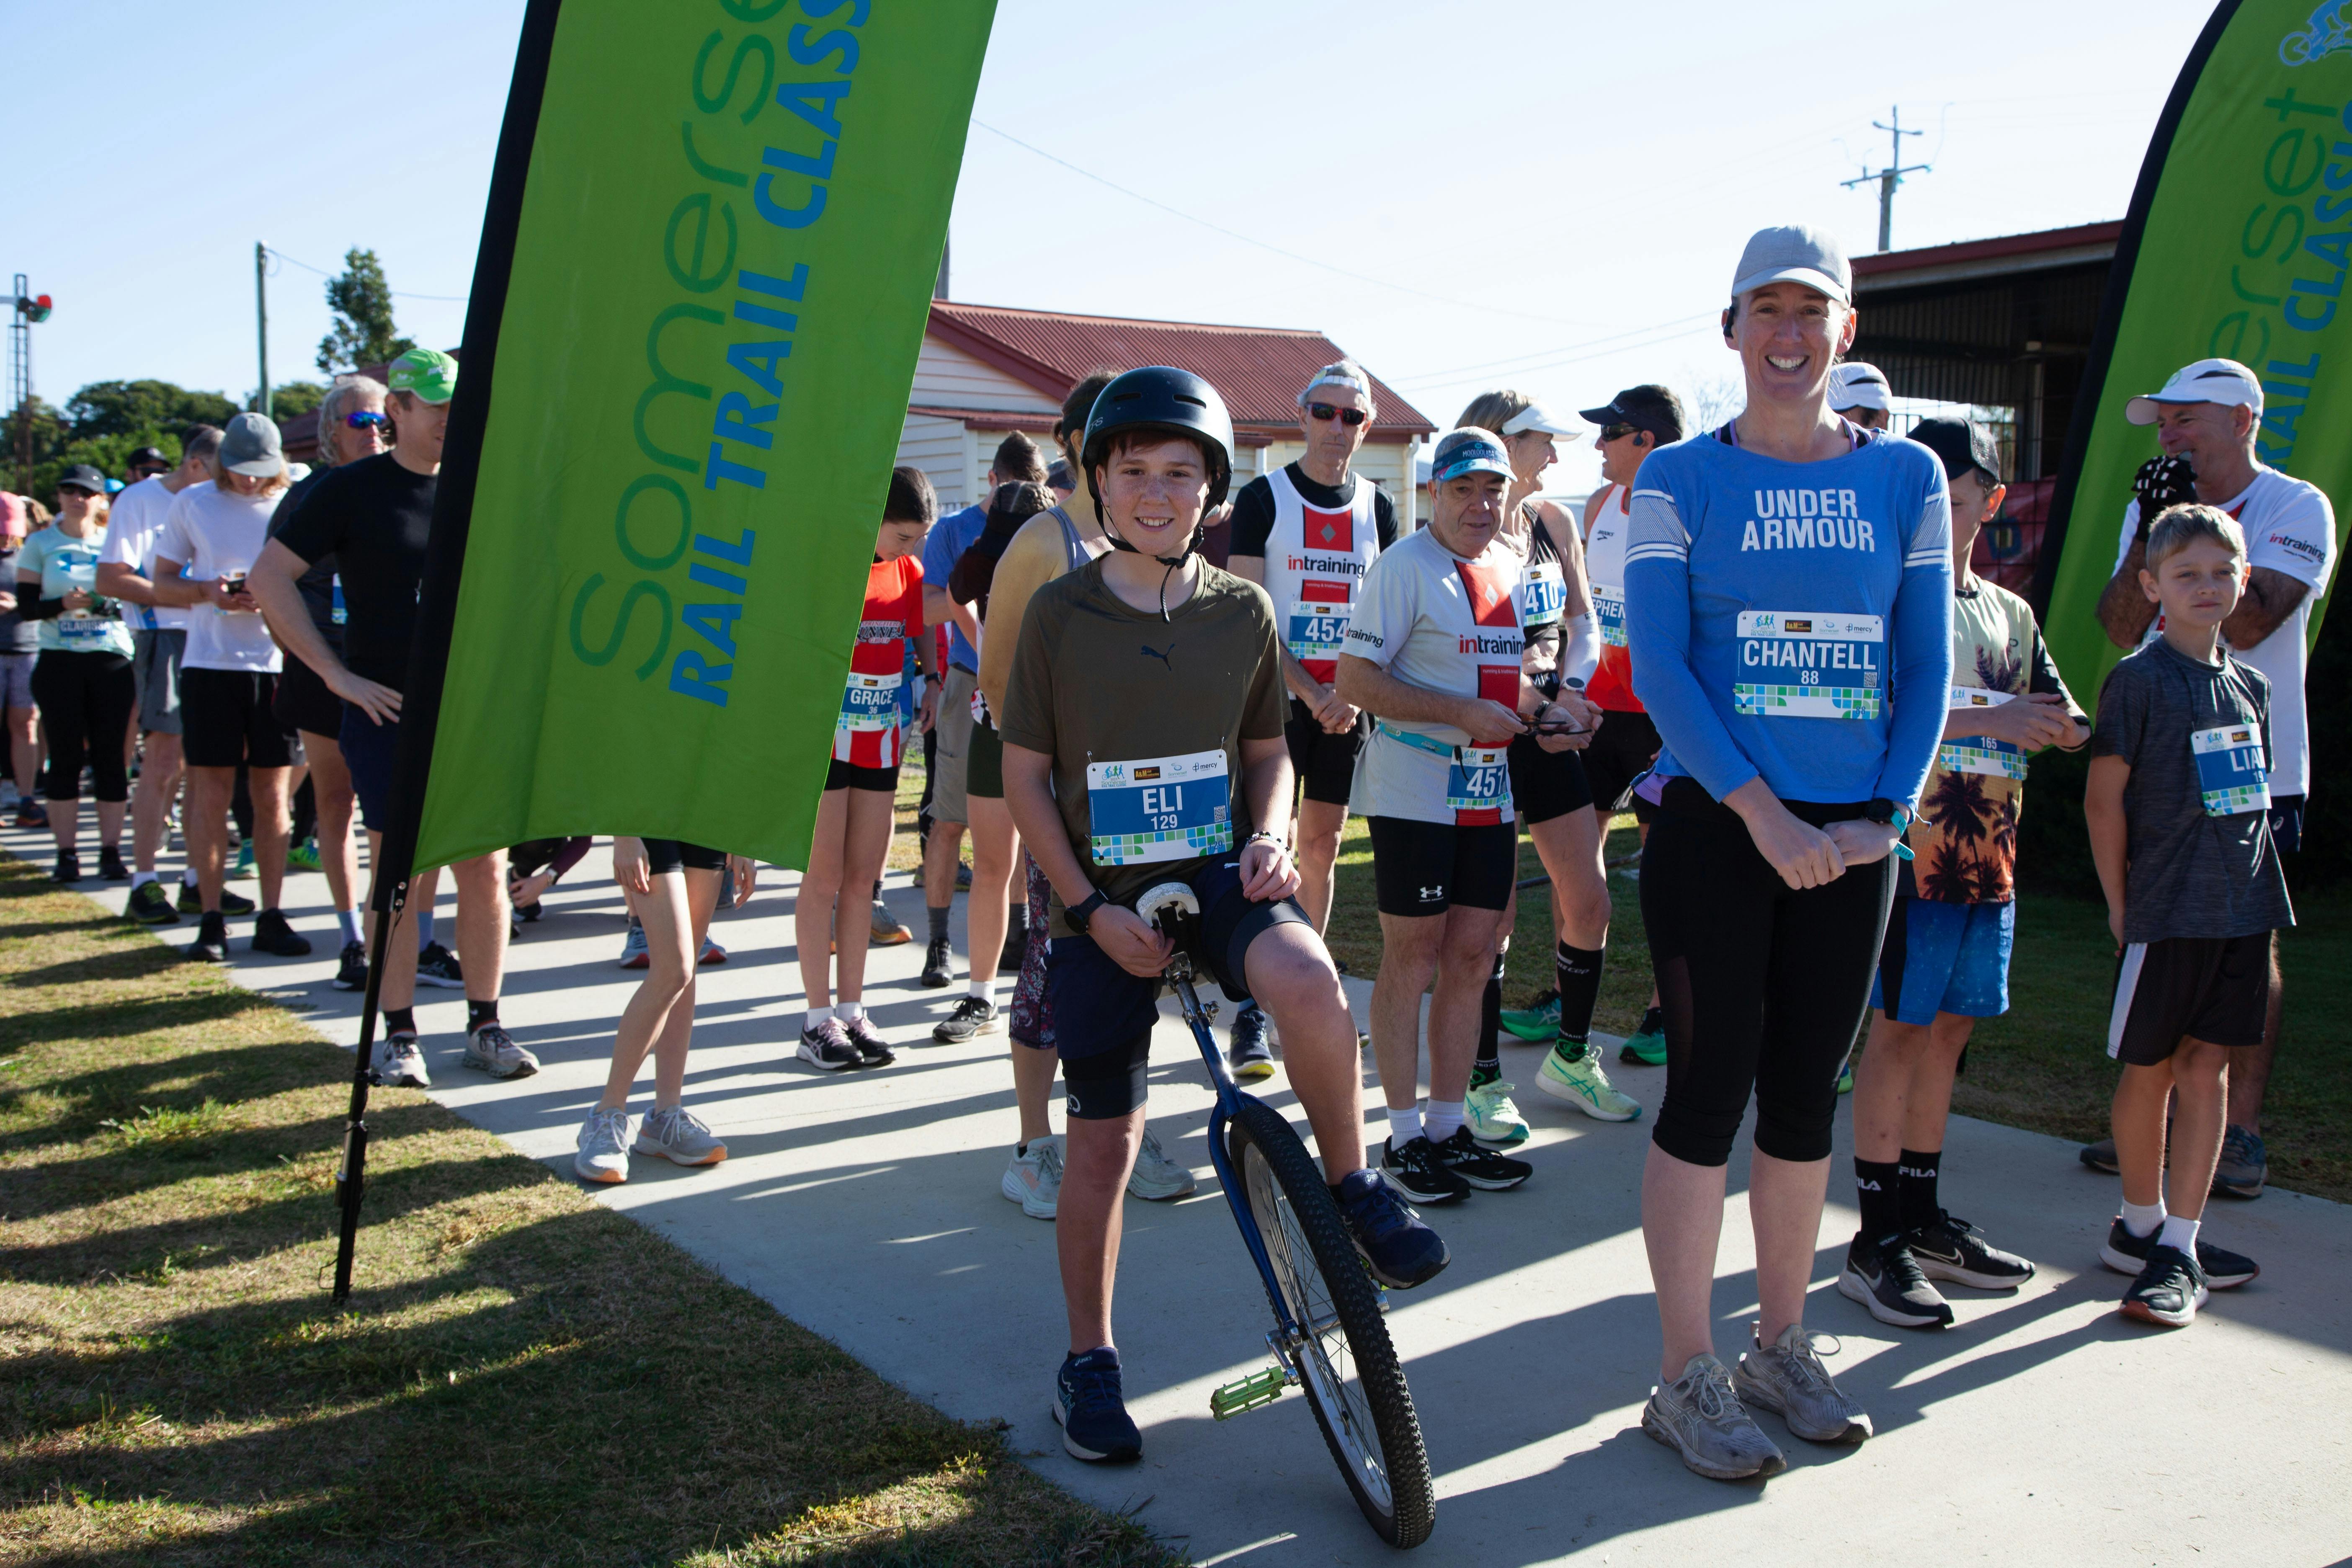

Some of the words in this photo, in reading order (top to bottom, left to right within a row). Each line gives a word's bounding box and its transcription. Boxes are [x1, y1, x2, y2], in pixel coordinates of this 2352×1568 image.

[570, 0, 788, 682] Somers
[704, 263, 810, 490] TRAIL
[2255, 353, 2321, 473] RAIL
[1755, 489, 1858, 518] UNDER
[1741, 518, 1875, 552] ARMOUR
[2269, 533, 2326, 563] intraining
[1288, 554, 1365, 579] intraining
[1526, 580, 1559, 613] 410
[669, 528, 756, 708] RAIL
[1305, 618, 1348, 642] 454
[1744, 640, 1876, 670] CHANTELL
[1801, 670, 1819, 684] 88
[850, 689, 894, 705] GRACE
[868, 706, 878, 714] 36
[1981, 736, 1997, 750] 165
[1466, 766, 1505, 797] 451
[1142, 785, 1183, 814] ELI
[1151, 814, 1178, 830] 129
[1208, 840, 1223, 851] 129
[1899, 1166, 1936, 1177] FILA
